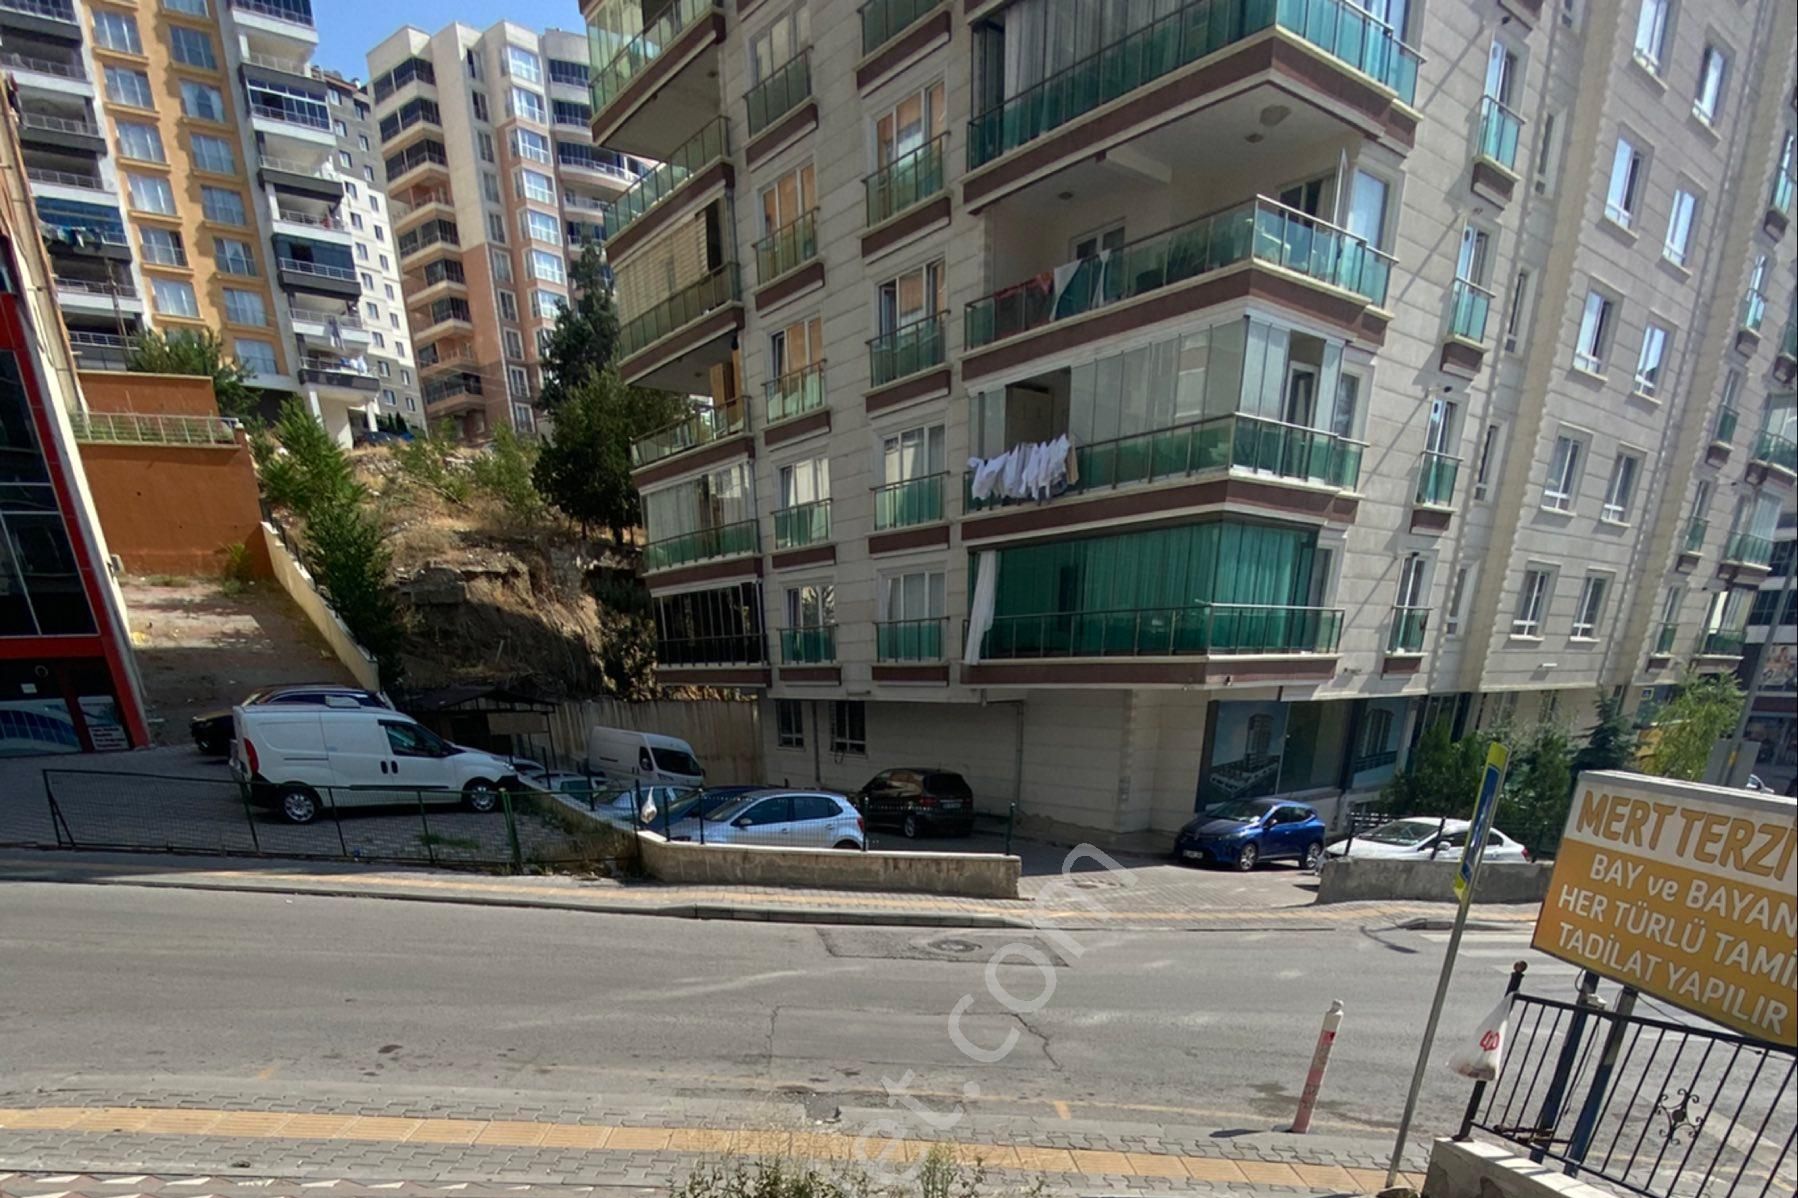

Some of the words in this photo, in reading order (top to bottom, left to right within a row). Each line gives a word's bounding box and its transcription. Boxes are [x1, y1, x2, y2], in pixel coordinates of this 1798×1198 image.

[1576, 790, 1677, 850] MERT
[1558, 884, 1608, 922] HER
[1616, 901, 1706, 954] TÜRLÜ
[1714, 931, 1797, 991] TAMİ
[1590, 854, 1644, 890] BAY
[1648, 875, 1679, 901] ve
[1685, 880, 1797, 938] BAYAN
[1559, 921, 1663, 982] TADİLAT
[1668, 961, 1788, 1035] YAPILIR
